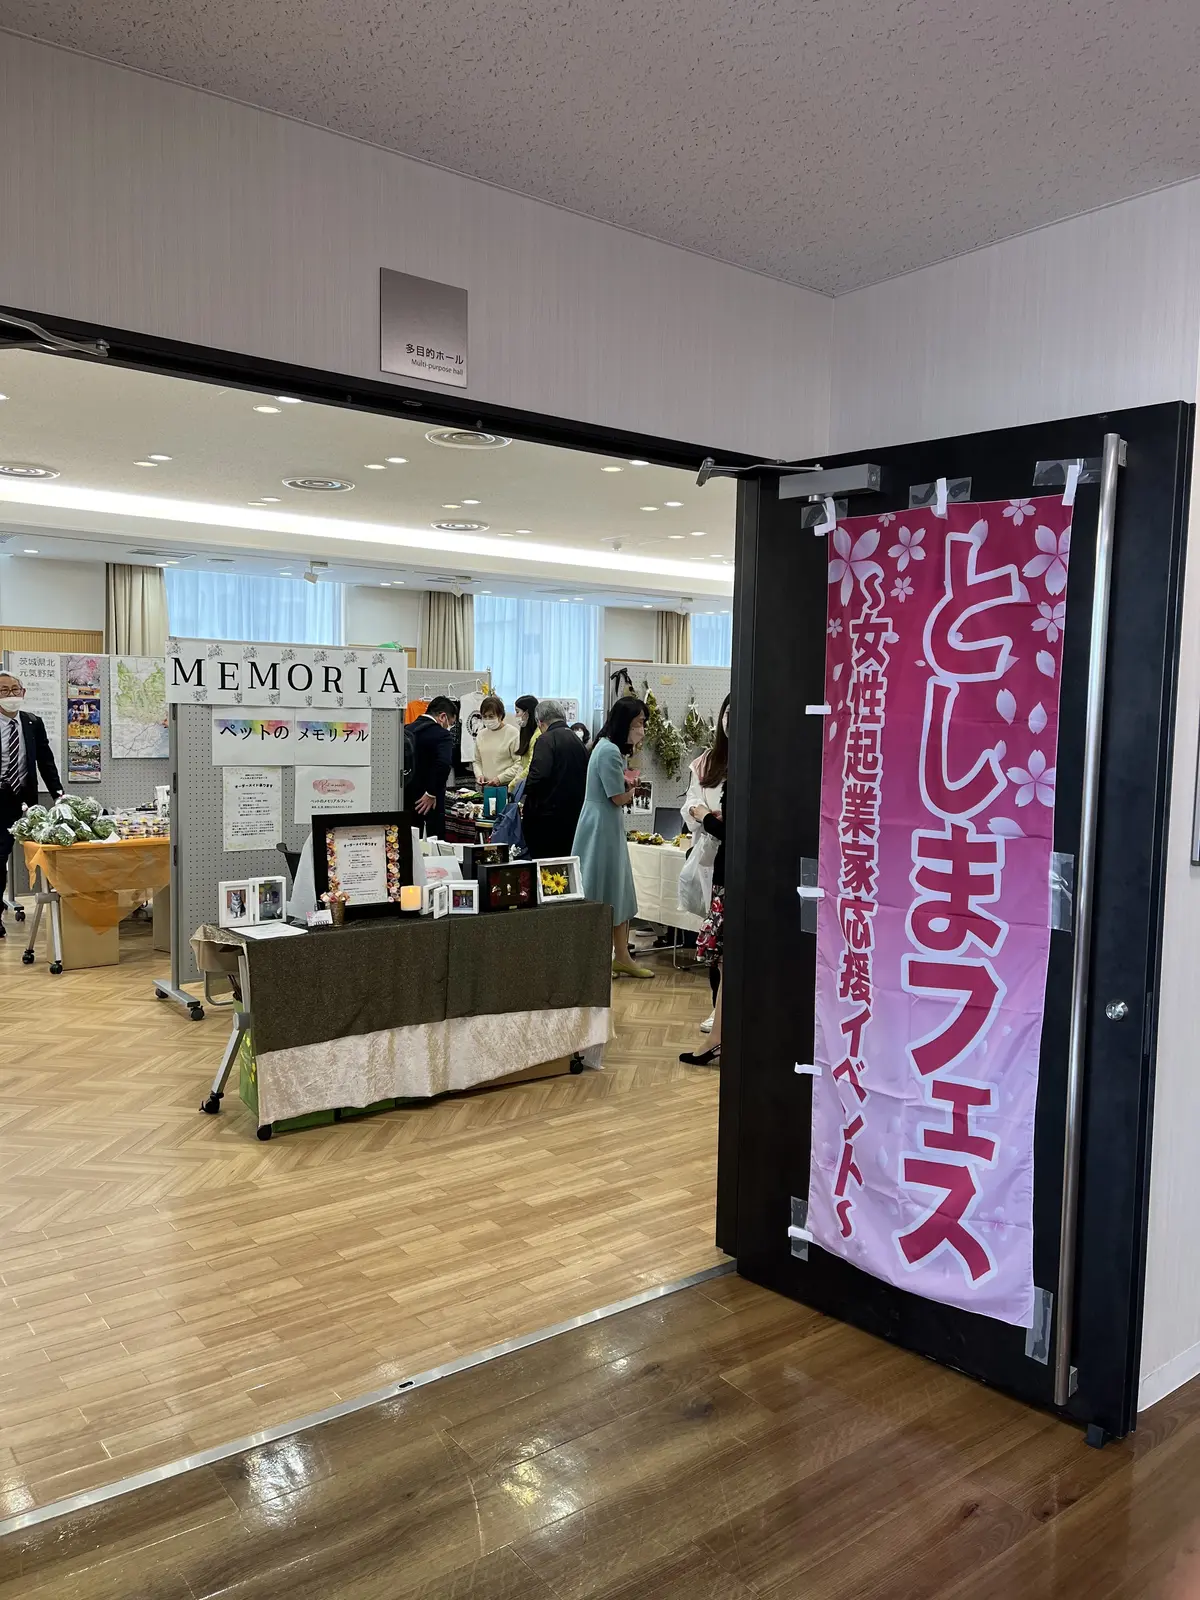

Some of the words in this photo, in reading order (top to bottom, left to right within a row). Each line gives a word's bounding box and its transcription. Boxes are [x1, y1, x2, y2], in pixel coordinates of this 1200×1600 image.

[405, 343, 464, 365] 多目的ホール
[411, 358, 452, 373] Multi-purpose
[452, 365, 463, 375] hall
[19, 656, 56, 668] 茨城県北
[19, 668, 56, 678] 元気野菜
[170, 657, 402, 694] MEMORIA
[219, 723, 290, 741] ペットの
[297, 727, 370, 742] メモリアル
[898, 532, 1021, 1289] としまフェス
